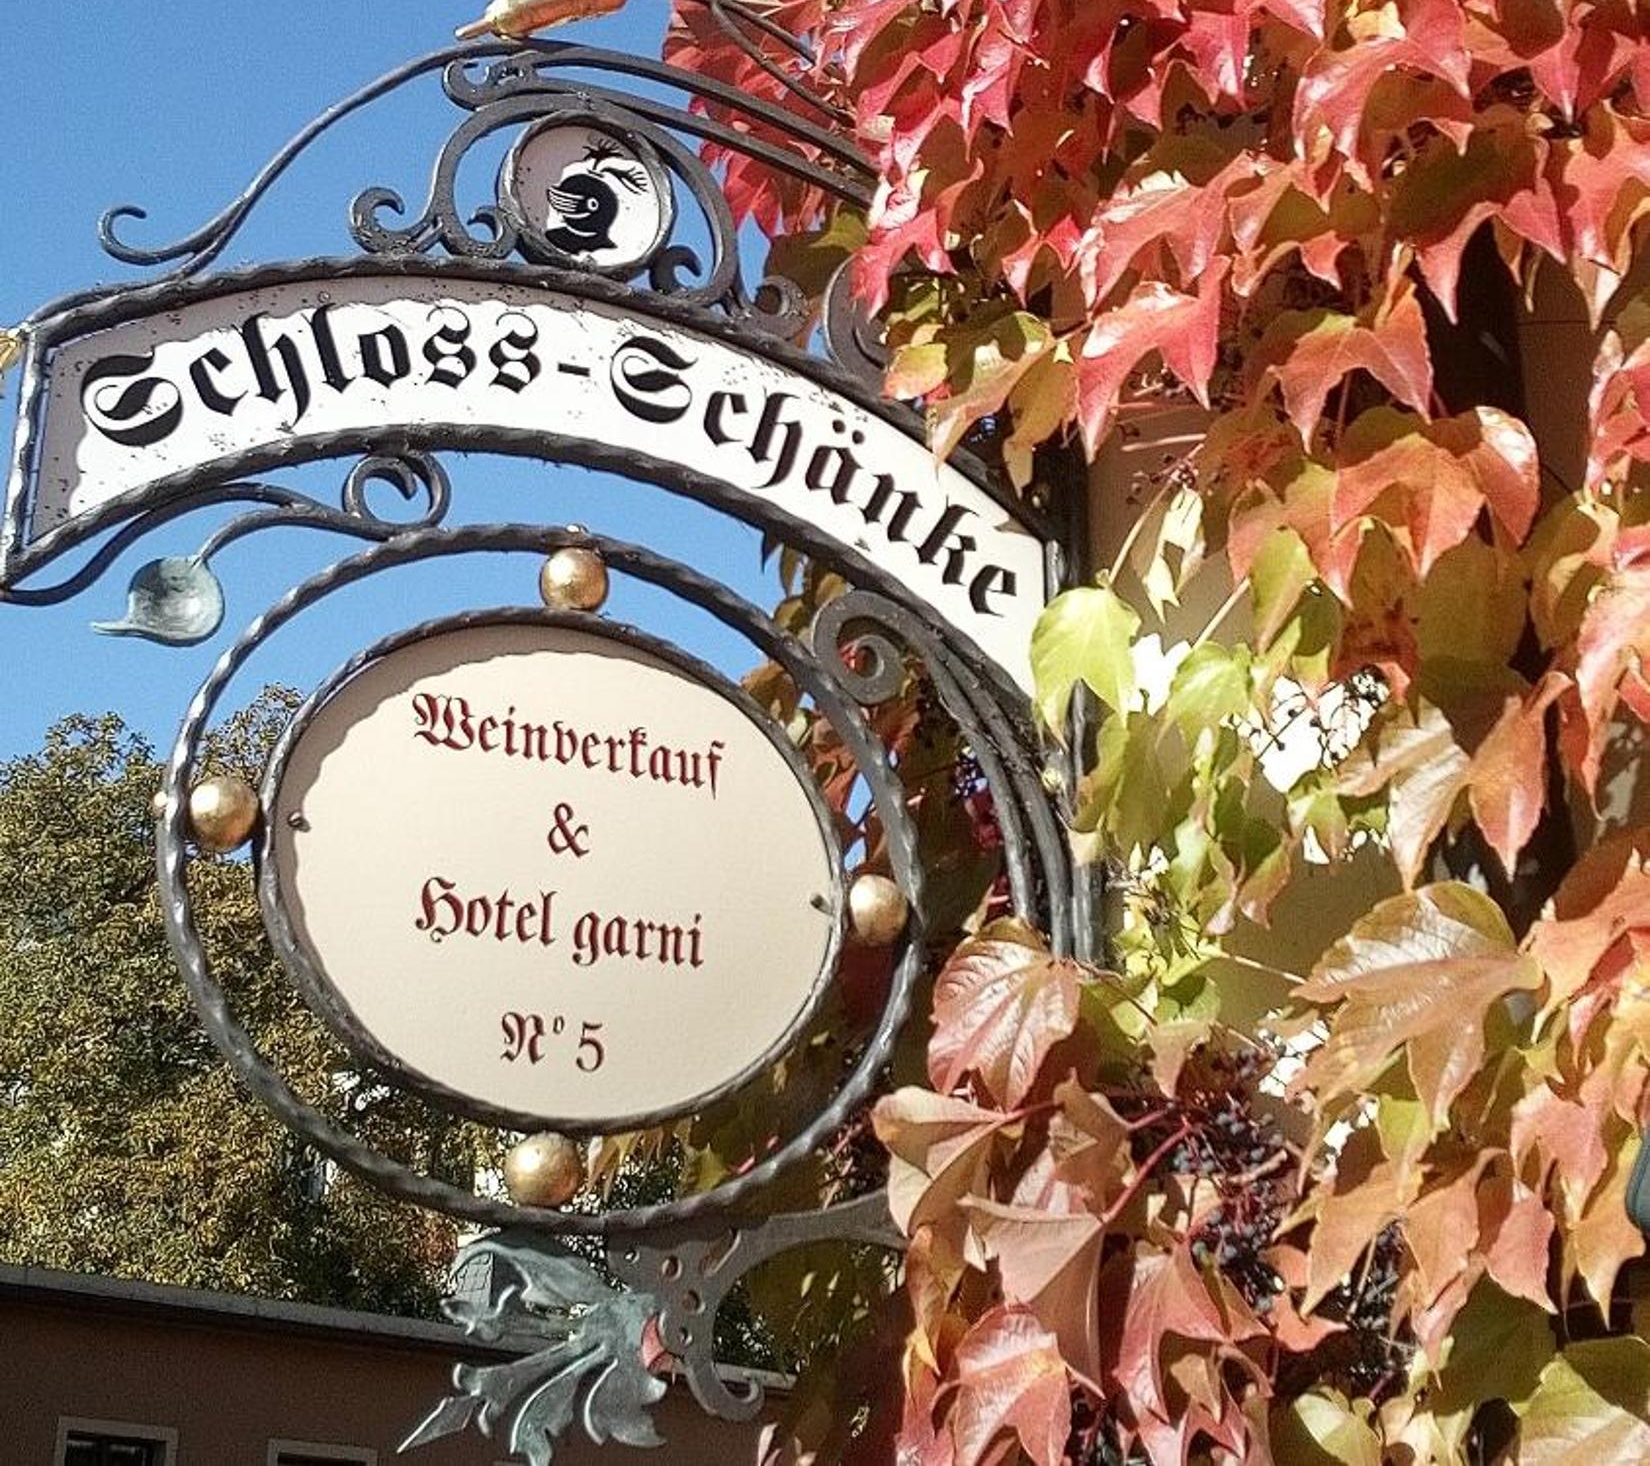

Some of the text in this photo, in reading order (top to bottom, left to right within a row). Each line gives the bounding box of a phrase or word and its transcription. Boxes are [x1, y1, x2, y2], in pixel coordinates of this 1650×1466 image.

[81, 300, 1019, 618] Schloss-Schänke
[412, 692, 725, 799] Weinverkauf
[547, 802, 590, 857] &
[415, 876, 704, 968] Hotel garni
[576, 1021, 605, 1073] 5
